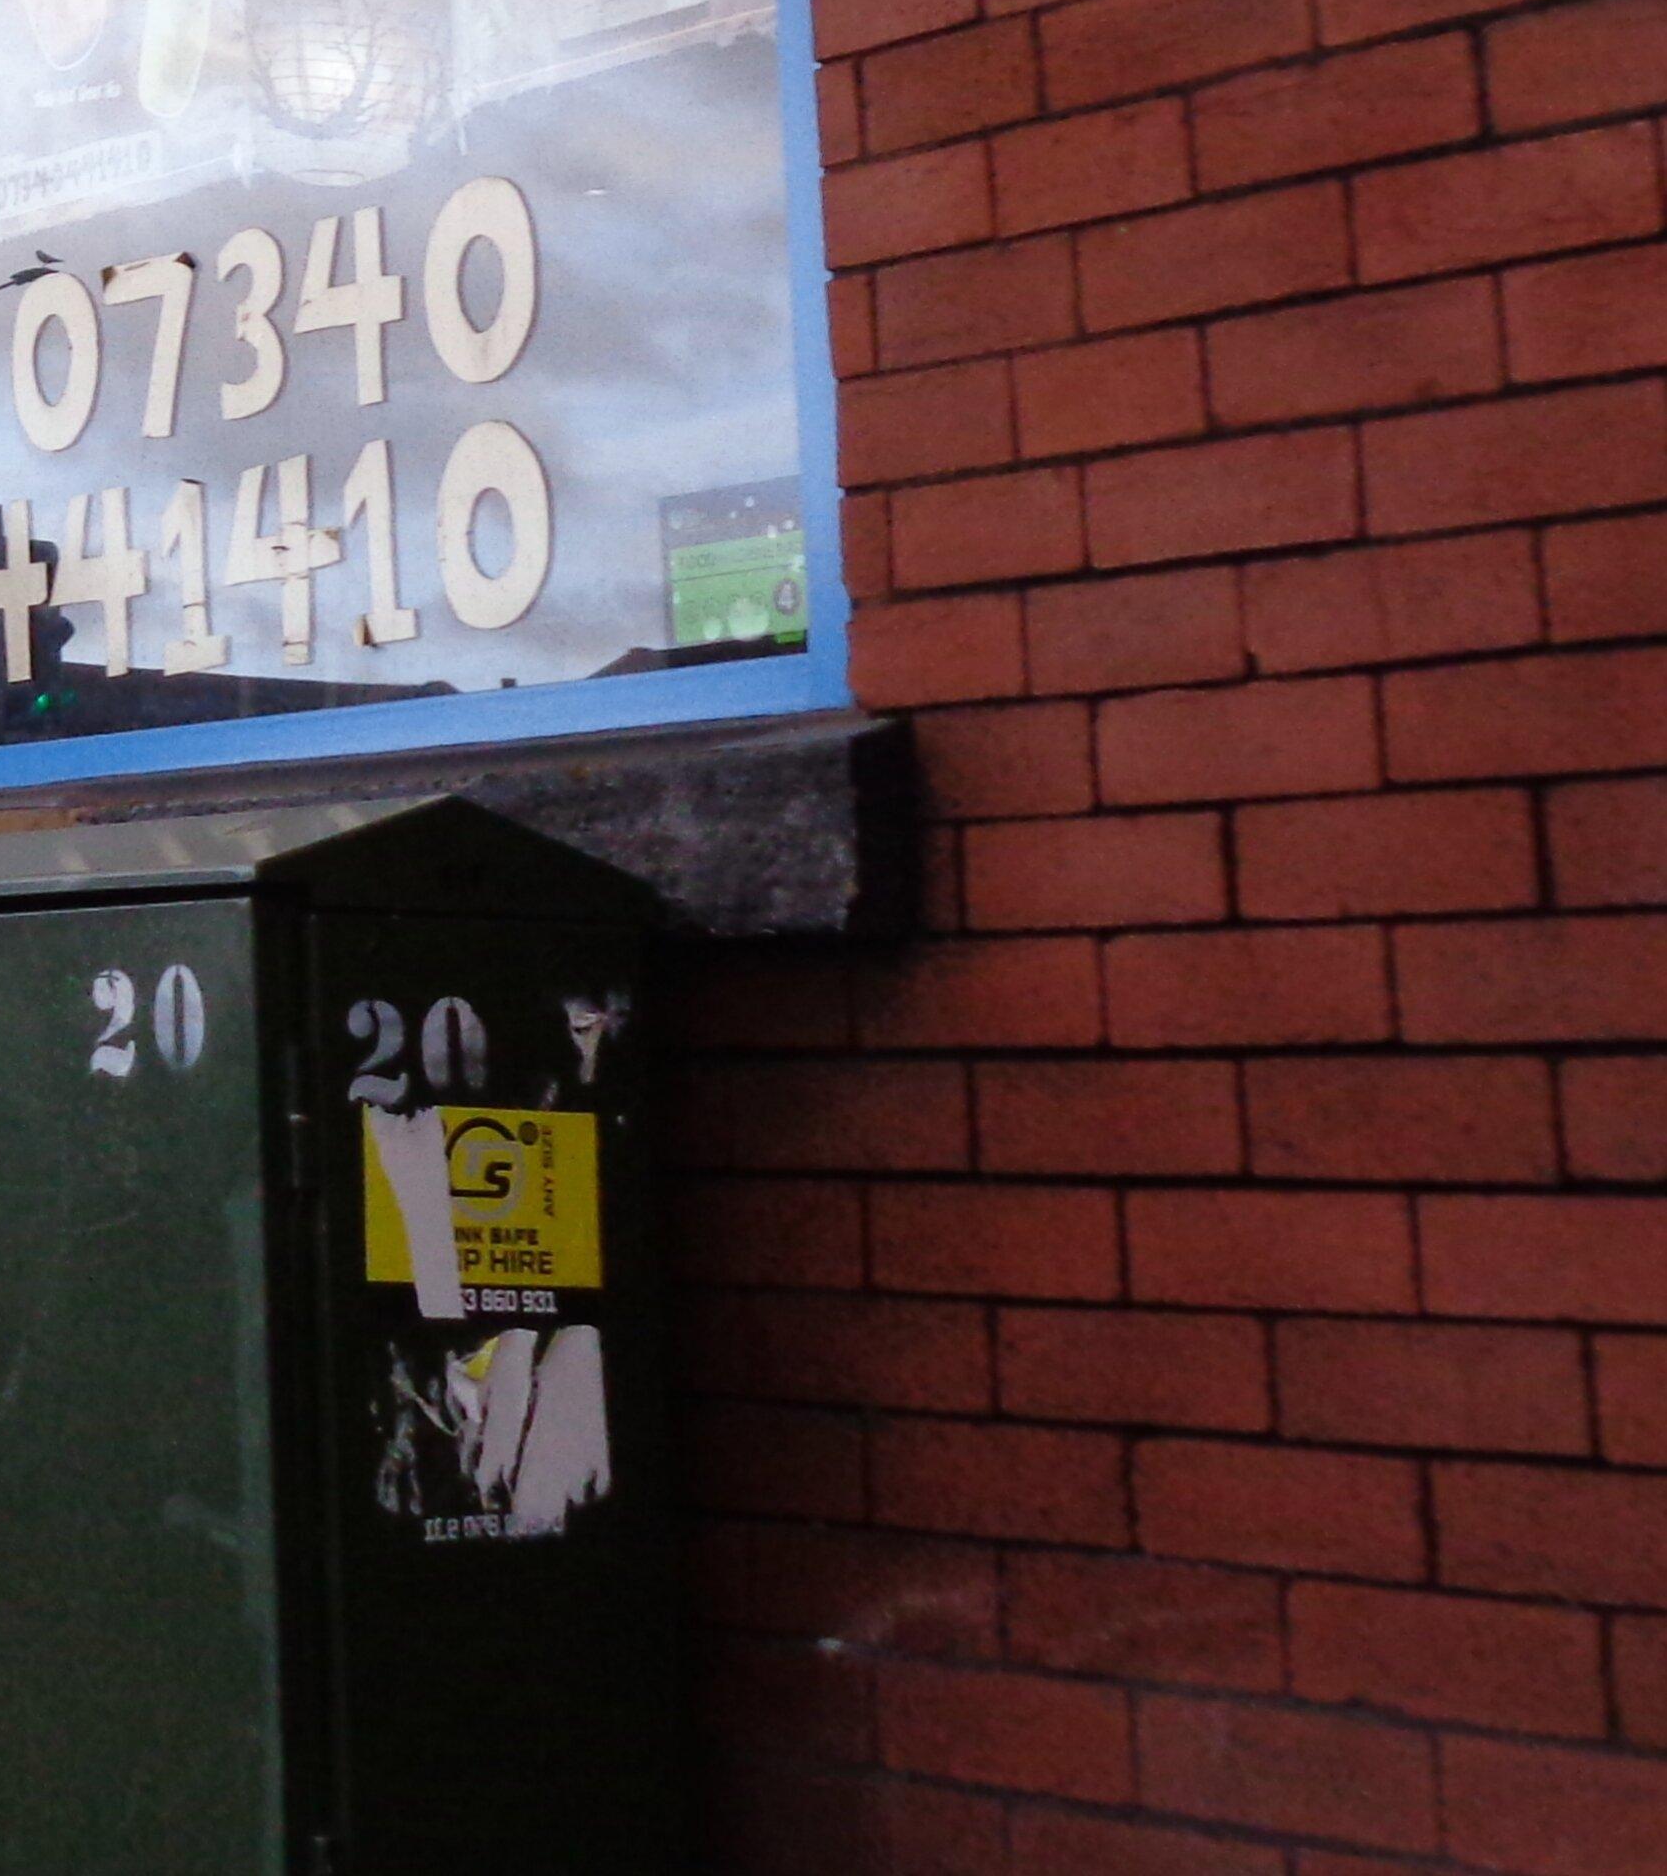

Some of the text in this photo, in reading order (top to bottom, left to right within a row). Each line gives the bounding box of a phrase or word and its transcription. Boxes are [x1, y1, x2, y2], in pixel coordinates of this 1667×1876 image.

[12, 176, 537, 452] 07340
[89, 964, 206, 1079] 20
[347, 996, 487, 1104] 20
[540, 1124, 555, 1218] ANY SIZE
[490, 1227, 540, 1246] SAFE
[490, 1250, 554, 1275] HIRE
[521, 1290, 558, 1314] 931
